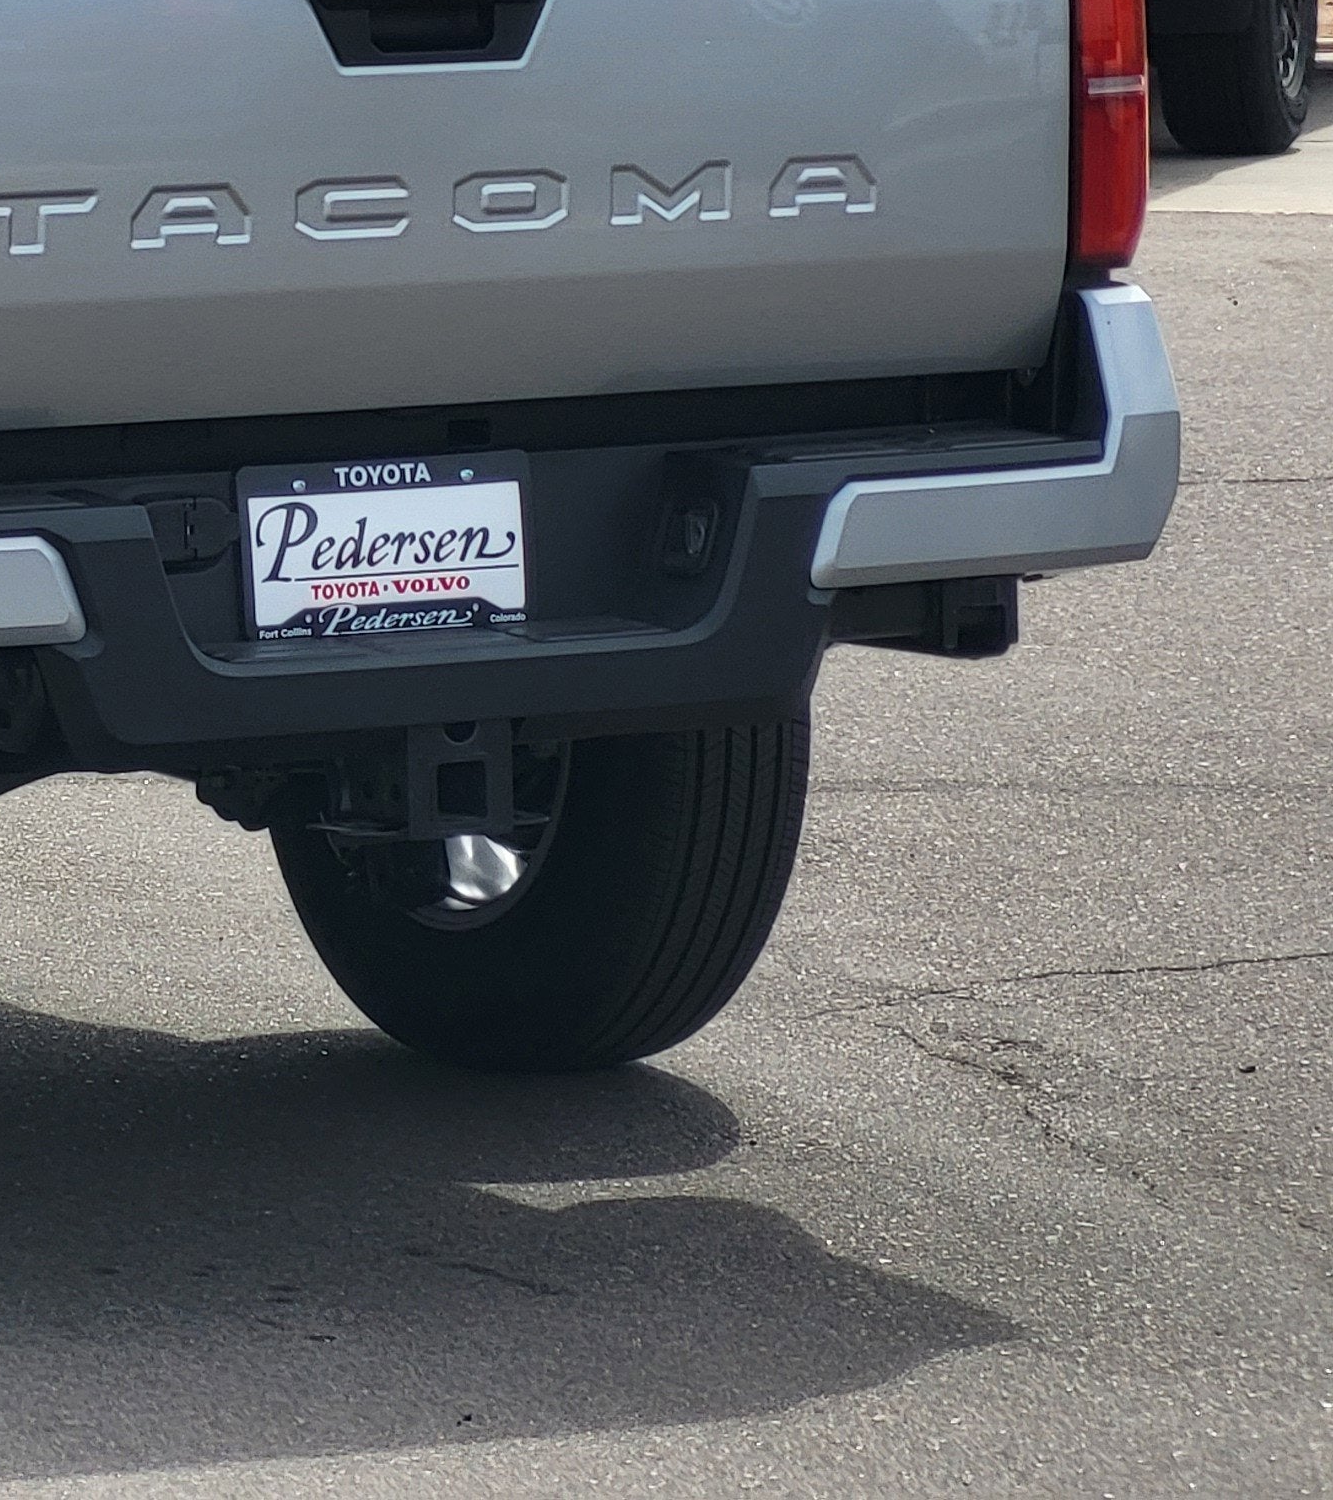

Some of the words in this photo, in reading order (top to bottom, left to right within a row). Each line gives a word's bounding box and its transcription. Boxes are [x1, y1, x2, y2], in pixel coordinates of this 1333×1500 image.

[334, 462, 431, 488] TOYOTA
[256, 501, 516, 583] Pedersen
[311, 580, 380, 600] TOYOTA
[391, 575, 471, 595] VOLVO
[318, 602, 473, 636] Pedersen
[490, 611, 526, 623] Colorado
[259, 630, 279, 639] Fort
[281, 627, 312, 638] Collins
